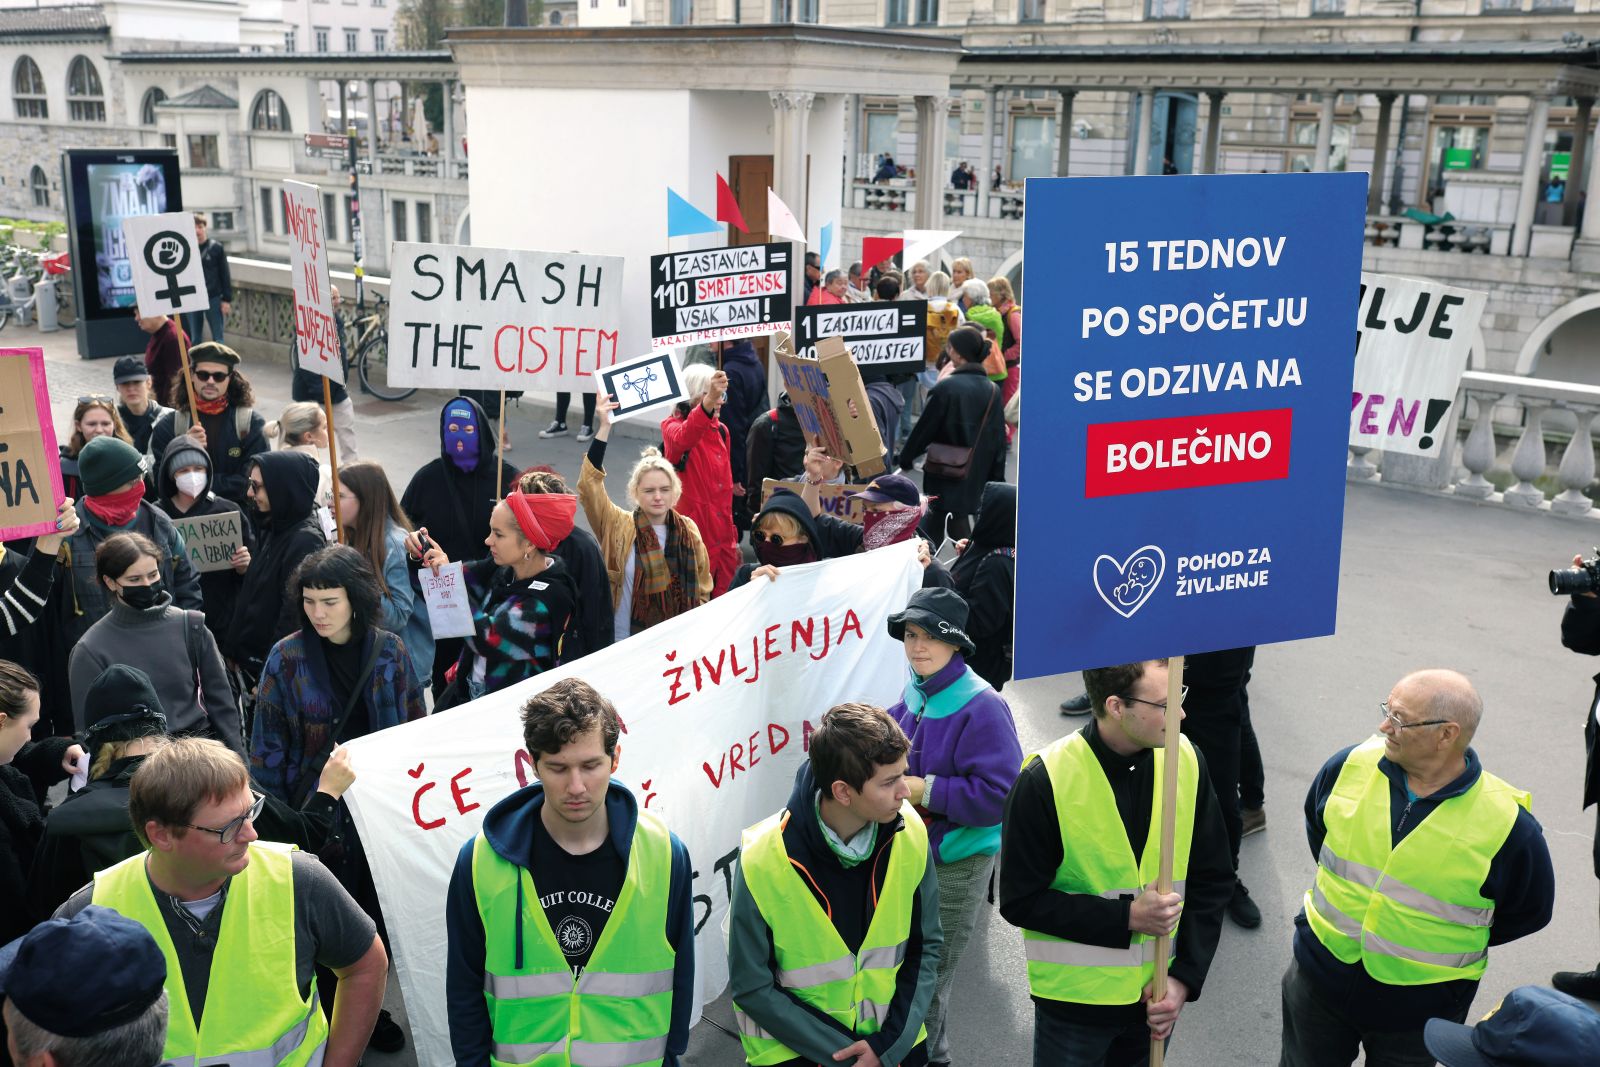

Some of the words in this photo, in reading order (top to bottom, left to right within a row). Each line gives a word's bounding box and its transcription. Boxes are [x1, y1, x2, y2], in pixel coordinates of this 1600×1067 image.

[659, 256, 671, 281] 1
[678, 250, 759, 276] ZASTAVICA
[1105, 241, 1139, 273] 15
[1147, 236, 1286, 271] TEDNOV
[304, 262, 320, 305] NI
[411, 254, 602, 307] SMASH
[653, 281, 689, 309] 110
[698, 277, 735, 300] SMRTI
[739, 272, 783, 295] ŽENSK
[680, 304, 719, 328] VSAK
[729, 302, 756, 321] DAN
[802, 315, 811, 339] 1
[822, 313, 894, 334] ZASTAVICA
[1081, 306, 1130, 338] PO
[1138, 292, 1307, 335] SPOČETJU
[404, 322, 482, 370] THE
[494, 325, 618, 376] CISTEM
[653, 334, 693, 348] ZARADI
[1073, 370, 1112, 402] SE
[1120, 362, 1248, 398] ODZIVA
[1255, 358, 1302, 388] NA
[1106, 427, 1272, 474] BOLEČINO
[201, 519, 237, 539] PIČKA
[204, 541, 237, 563] IZBIRA
[1177, 551, 1244, 573] POHOD
[1247, 547, 1272, 565] ZA
[1176, 570, 1269, 597] ŽIVLJENJE
[663, 609, 863, 705] ŽIVLJENJA
[408, 763, 481, 830] ČE
